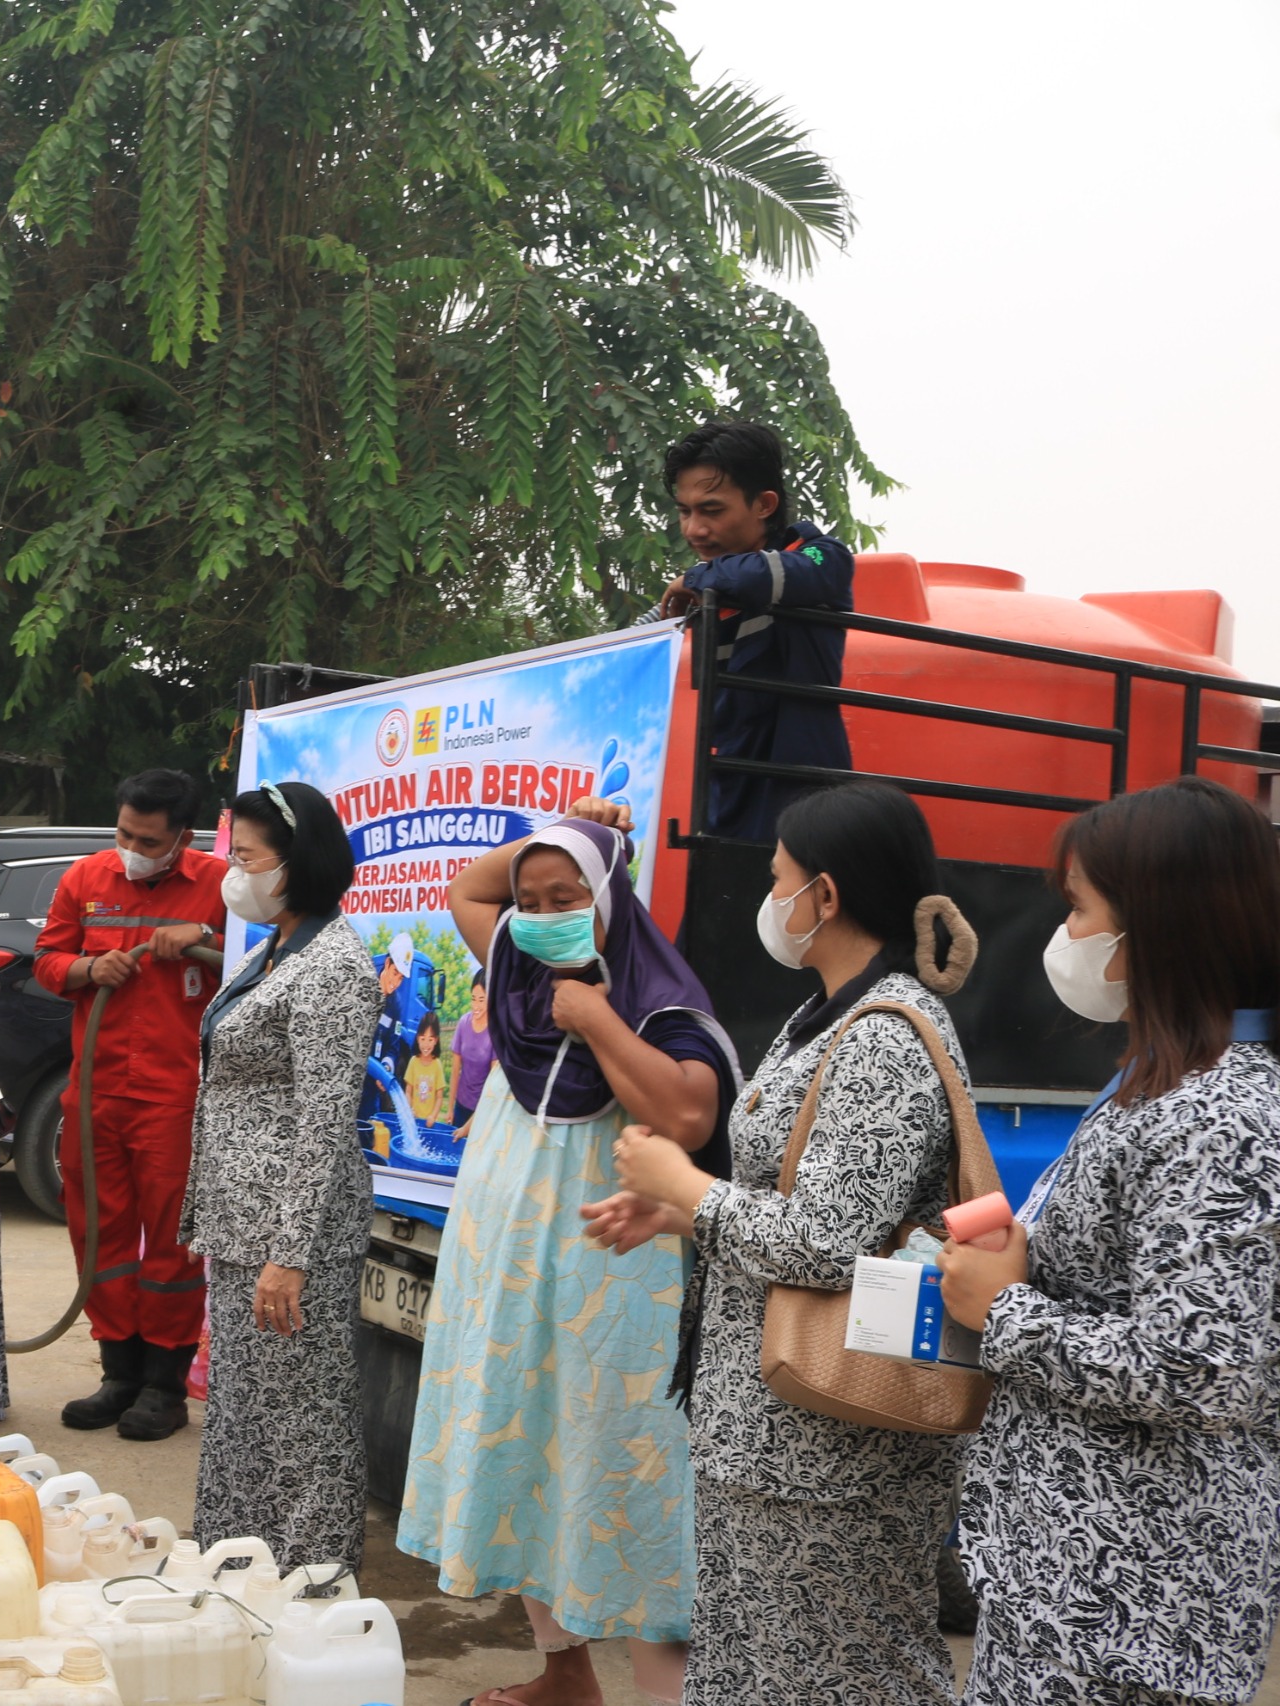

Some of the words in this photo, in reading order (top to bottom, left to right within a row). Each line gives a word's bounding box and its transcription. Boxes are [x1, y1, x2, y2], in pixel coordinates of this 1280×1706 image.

[445, 699, 495, 733] PLN
[444, 730, 494, 751] Indonesia
[496, 725, 532, 743] Power
[425, 767, 473, 807] AIR
[481, 765, 595, 815] BERSIH
[363, 823, 393, 857] IBI
[396, 813, 507, 848] SANGGAU
[364, 1264, 386, 1303] KB
